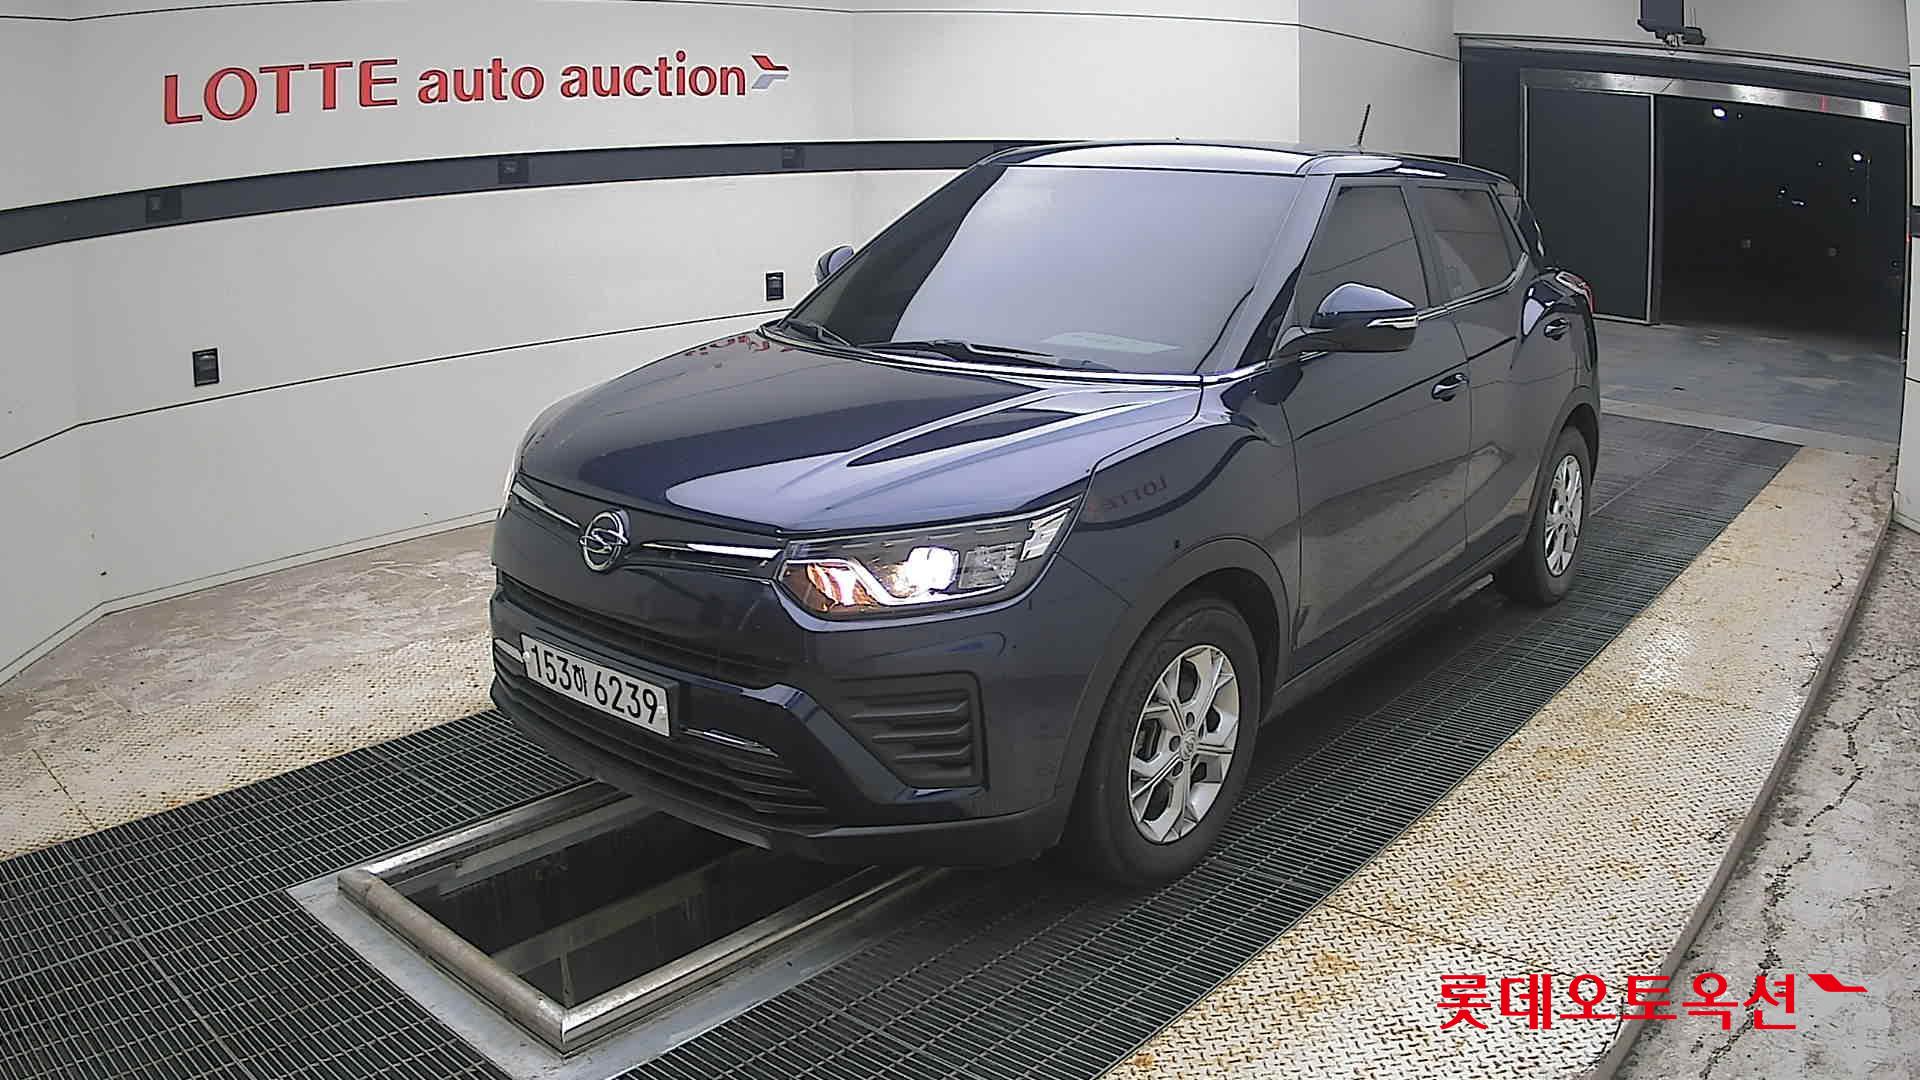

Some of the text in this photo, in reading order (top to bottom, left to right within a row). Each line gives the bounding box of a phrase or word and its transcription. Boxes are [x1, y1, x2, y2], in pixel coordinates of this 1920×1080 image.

[164, 50, 746, 125] LOTTE auto auction
[594, 671, 658, 724] 6239
